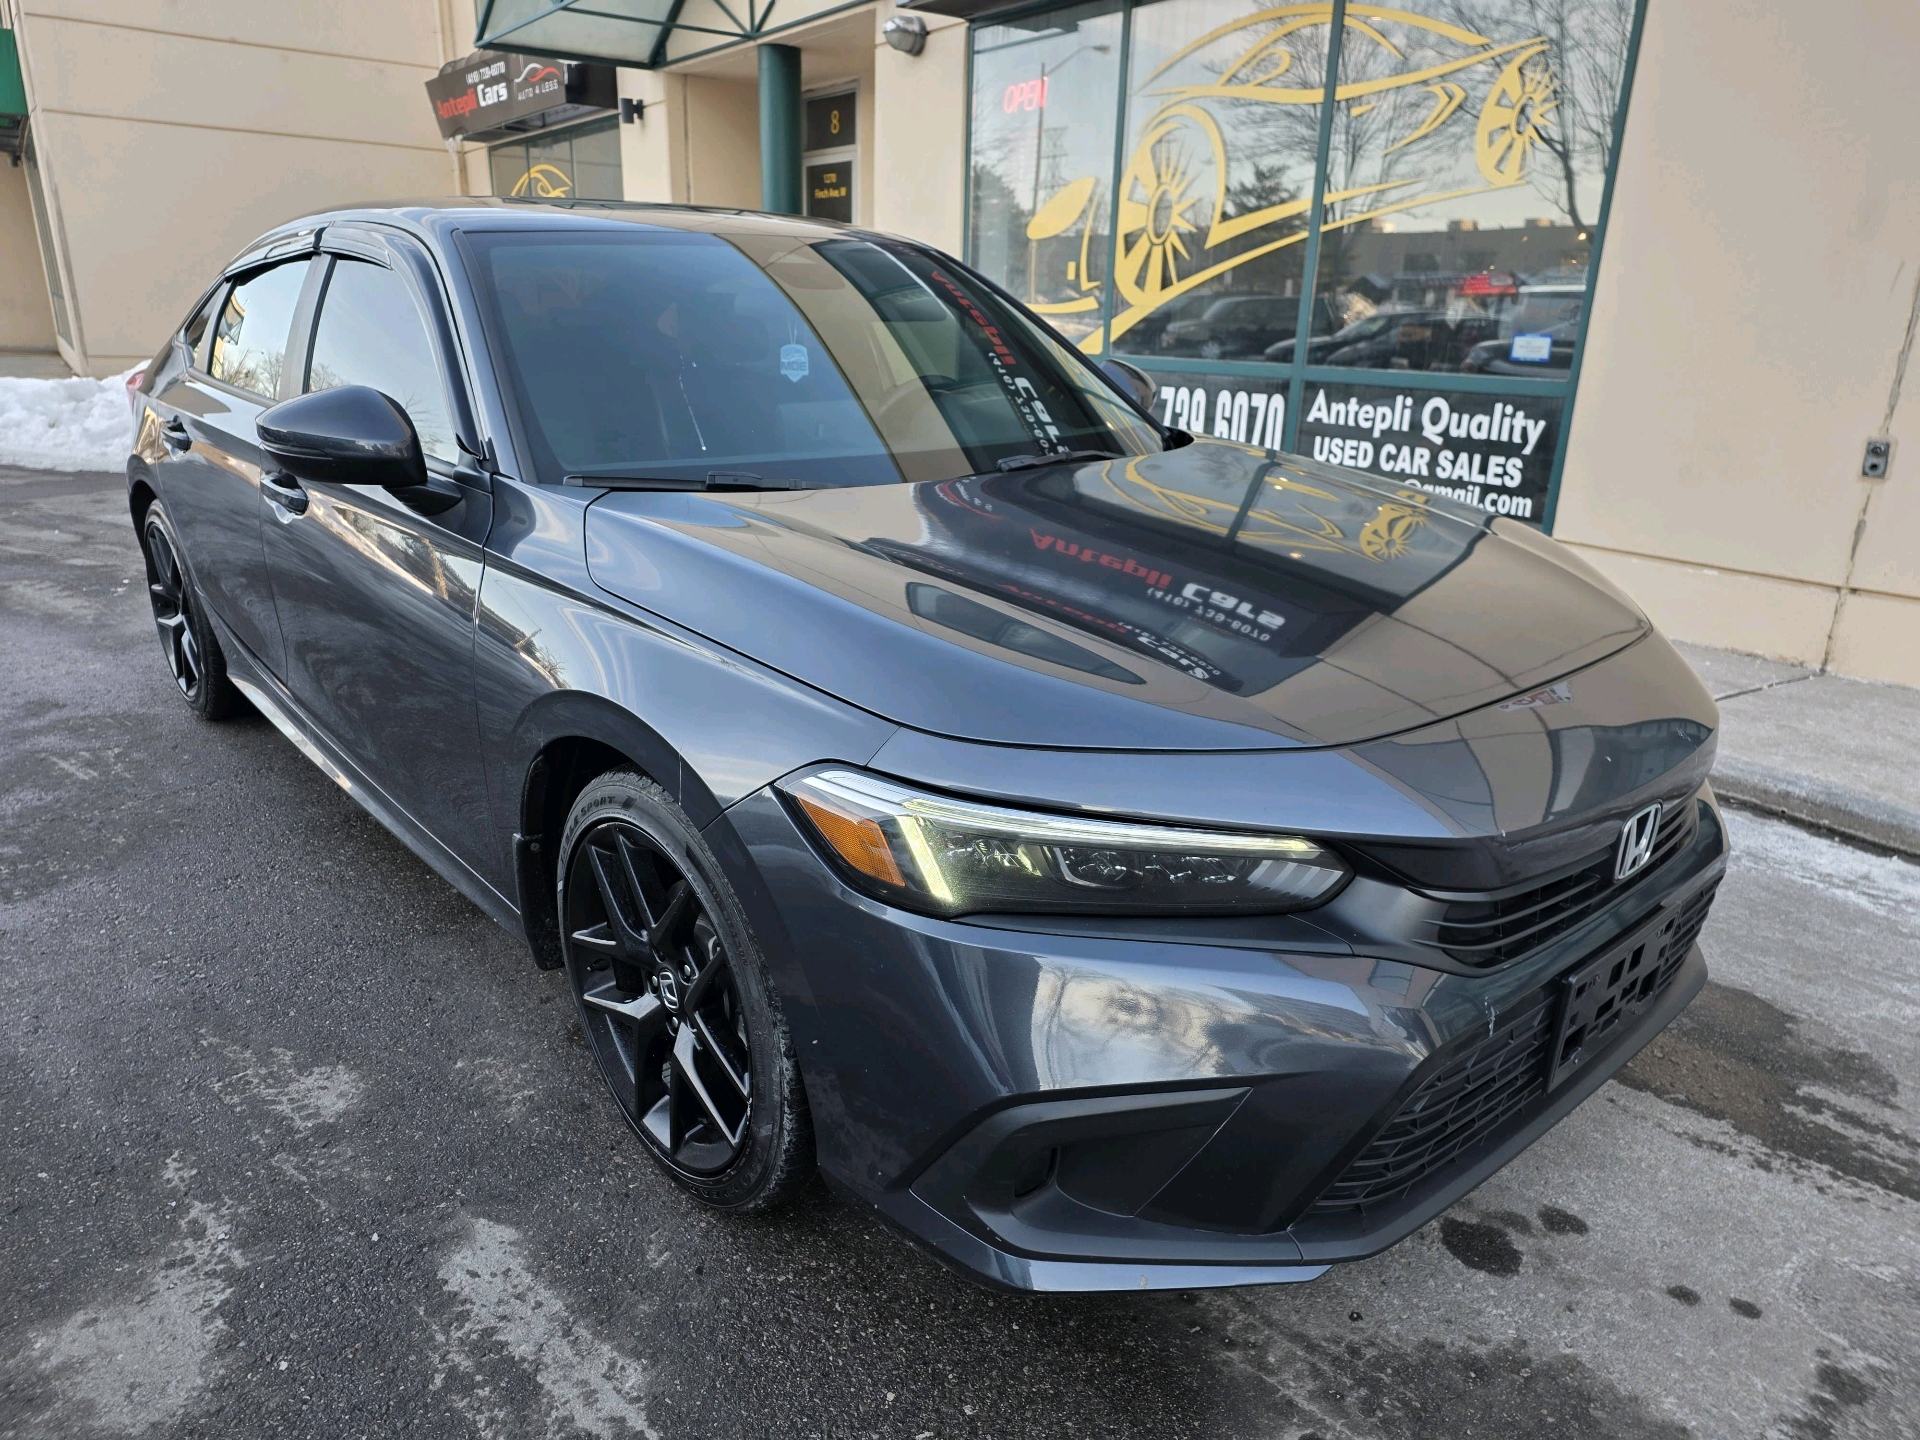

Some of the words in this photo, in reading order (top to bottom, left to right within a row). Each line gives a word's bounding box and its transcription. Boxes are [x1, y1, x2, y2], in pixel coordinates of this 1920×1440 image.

[436, 87, 478, 119] Antepli
[476, 82, 508, 107] Cars
[517, 88, 534, 101] AUTO
[541, 79, 559, 93] LESS
[1003, 78, 1048, 114] OPEN
[830, 109, 840, 134] 8
[1160, 386, 1207, 434] 739
[1213, 389, 1285, 451] 6070
[1306, 387, 1414, 438] Antepli
[1420, 396, 1546, 456] Quality
[1313, 435, 1375, 469] USED
[1379, 442, 1431, 477] CAR
[1435, 450, 1524, 489] SALES
